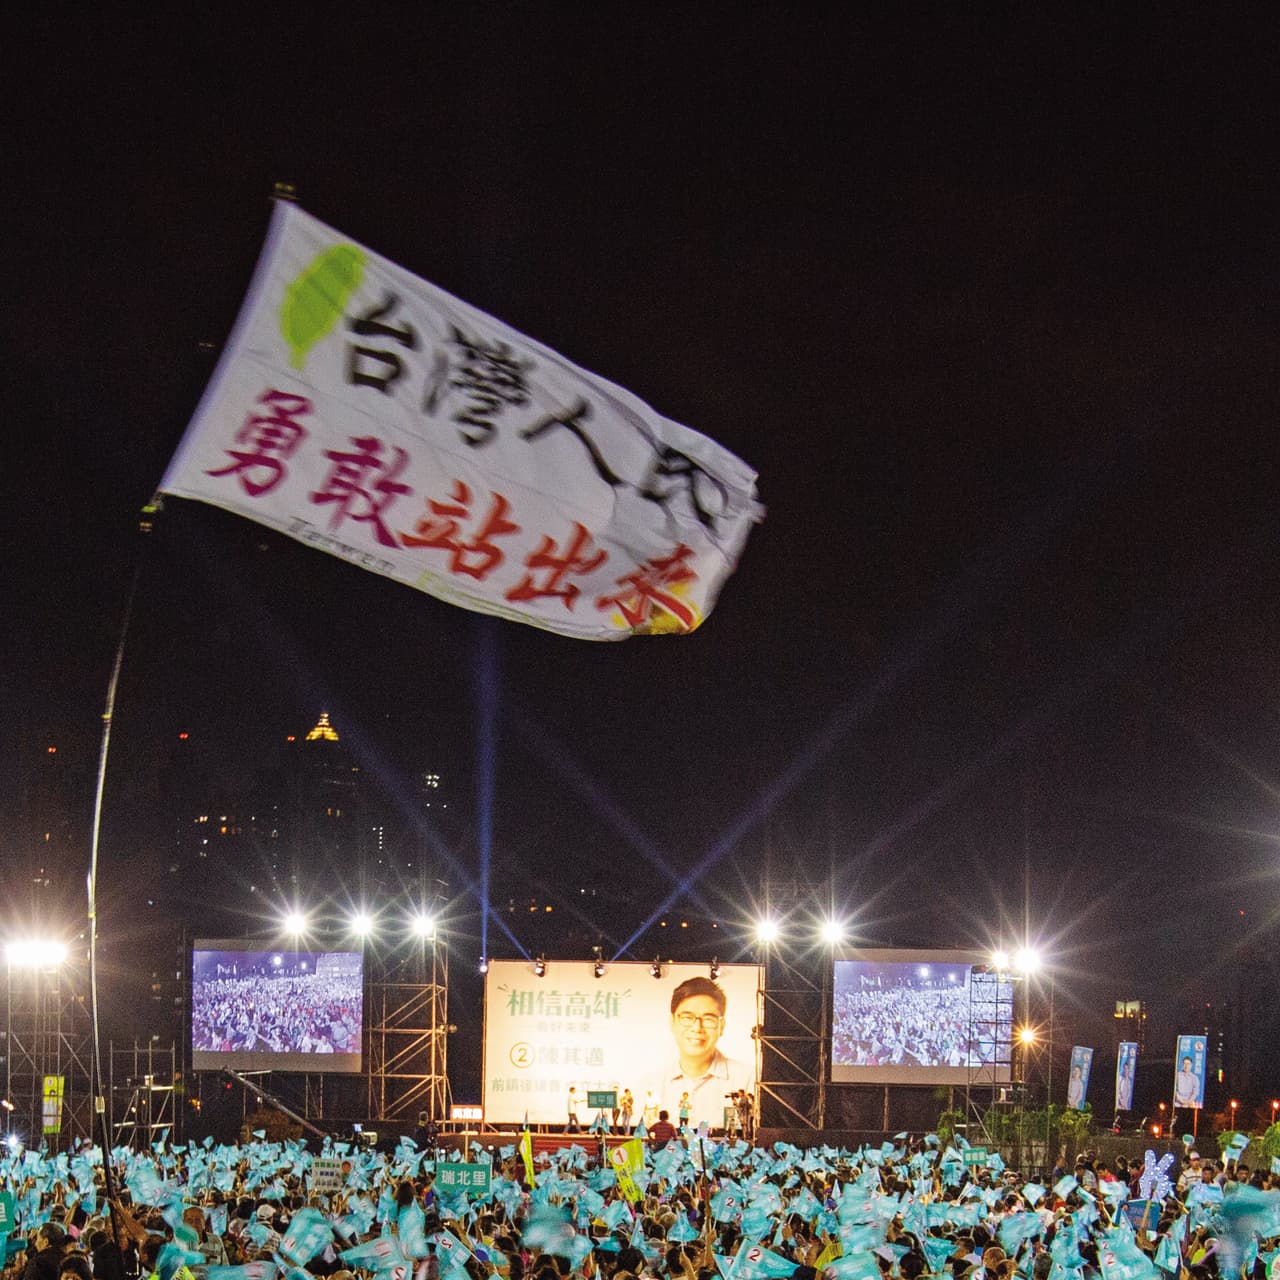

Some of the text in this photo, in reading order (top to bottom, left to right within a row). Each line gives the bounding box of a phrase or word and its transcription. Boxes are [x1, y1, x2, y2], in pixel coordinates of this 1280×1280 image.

[345, 292, 728, 530] 台灣人民
[506, 989, 620, 1019] 相信高雄
[441, 1170, 486, 1186] 瑞北里
